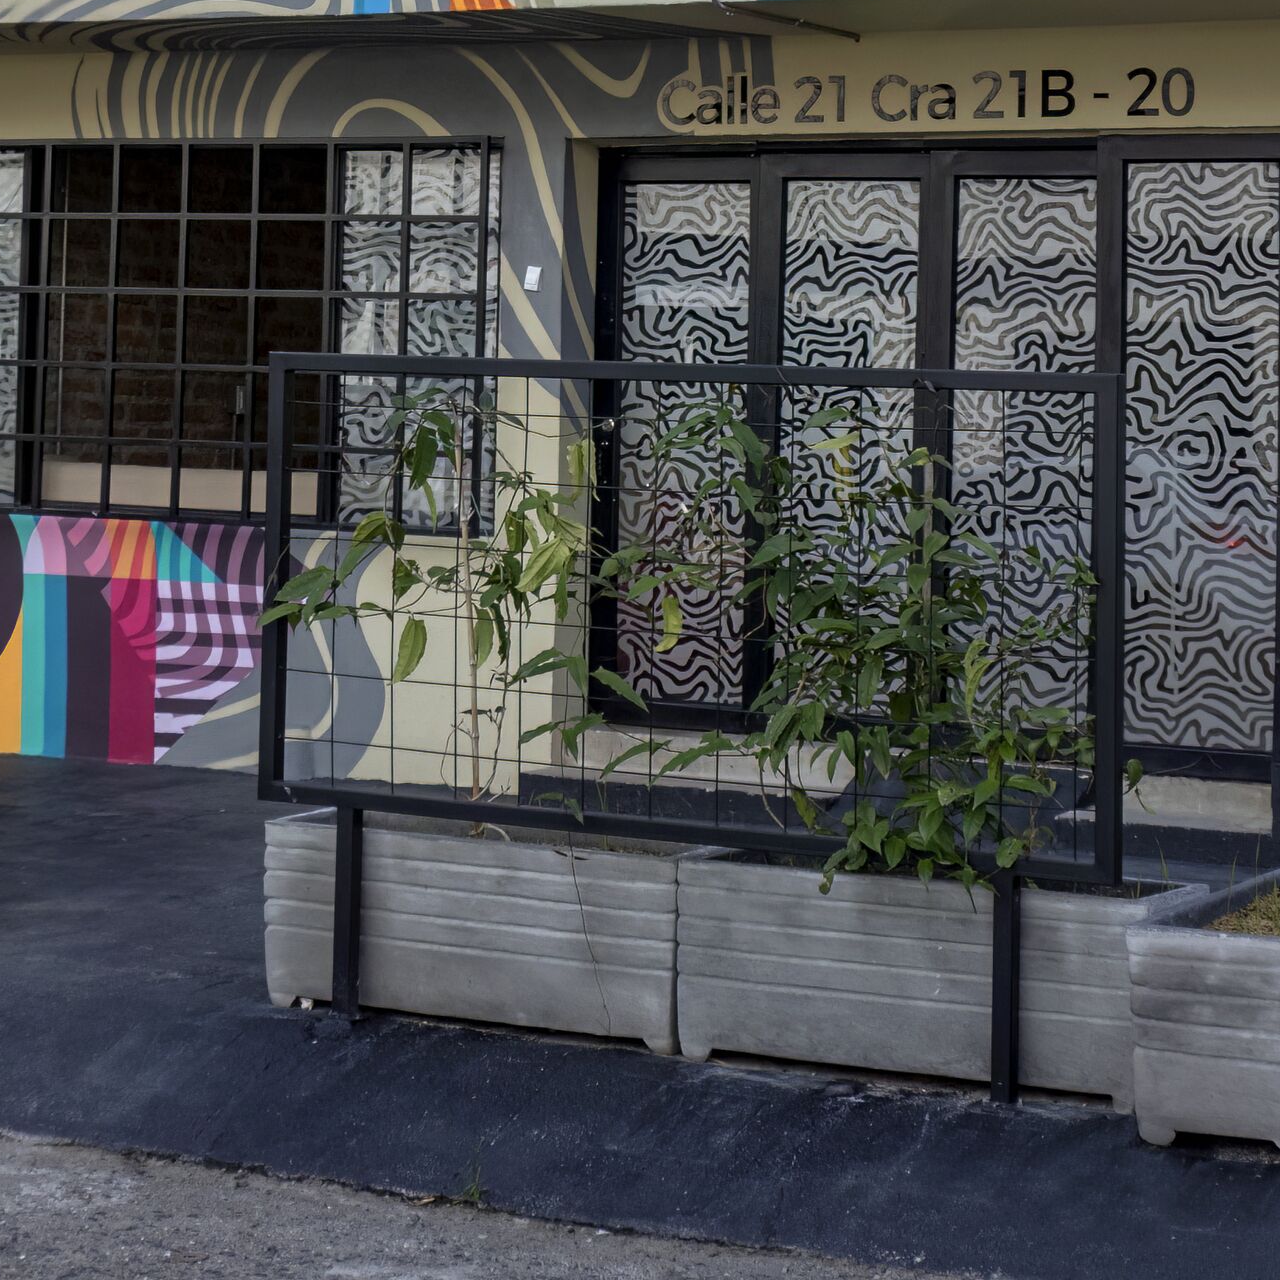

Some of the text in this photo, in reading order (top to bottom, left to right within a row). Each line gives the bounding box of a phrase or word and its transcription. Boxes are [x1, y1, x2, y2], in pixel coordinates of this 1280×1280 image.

[663, 75, 781, 125] Calle
[794, 75, 846, 122] 21
[871, 74, 957, 122] Cra
[972, 70, 1076, 119] 21B
[1127, 67, 1196, 117] 20
